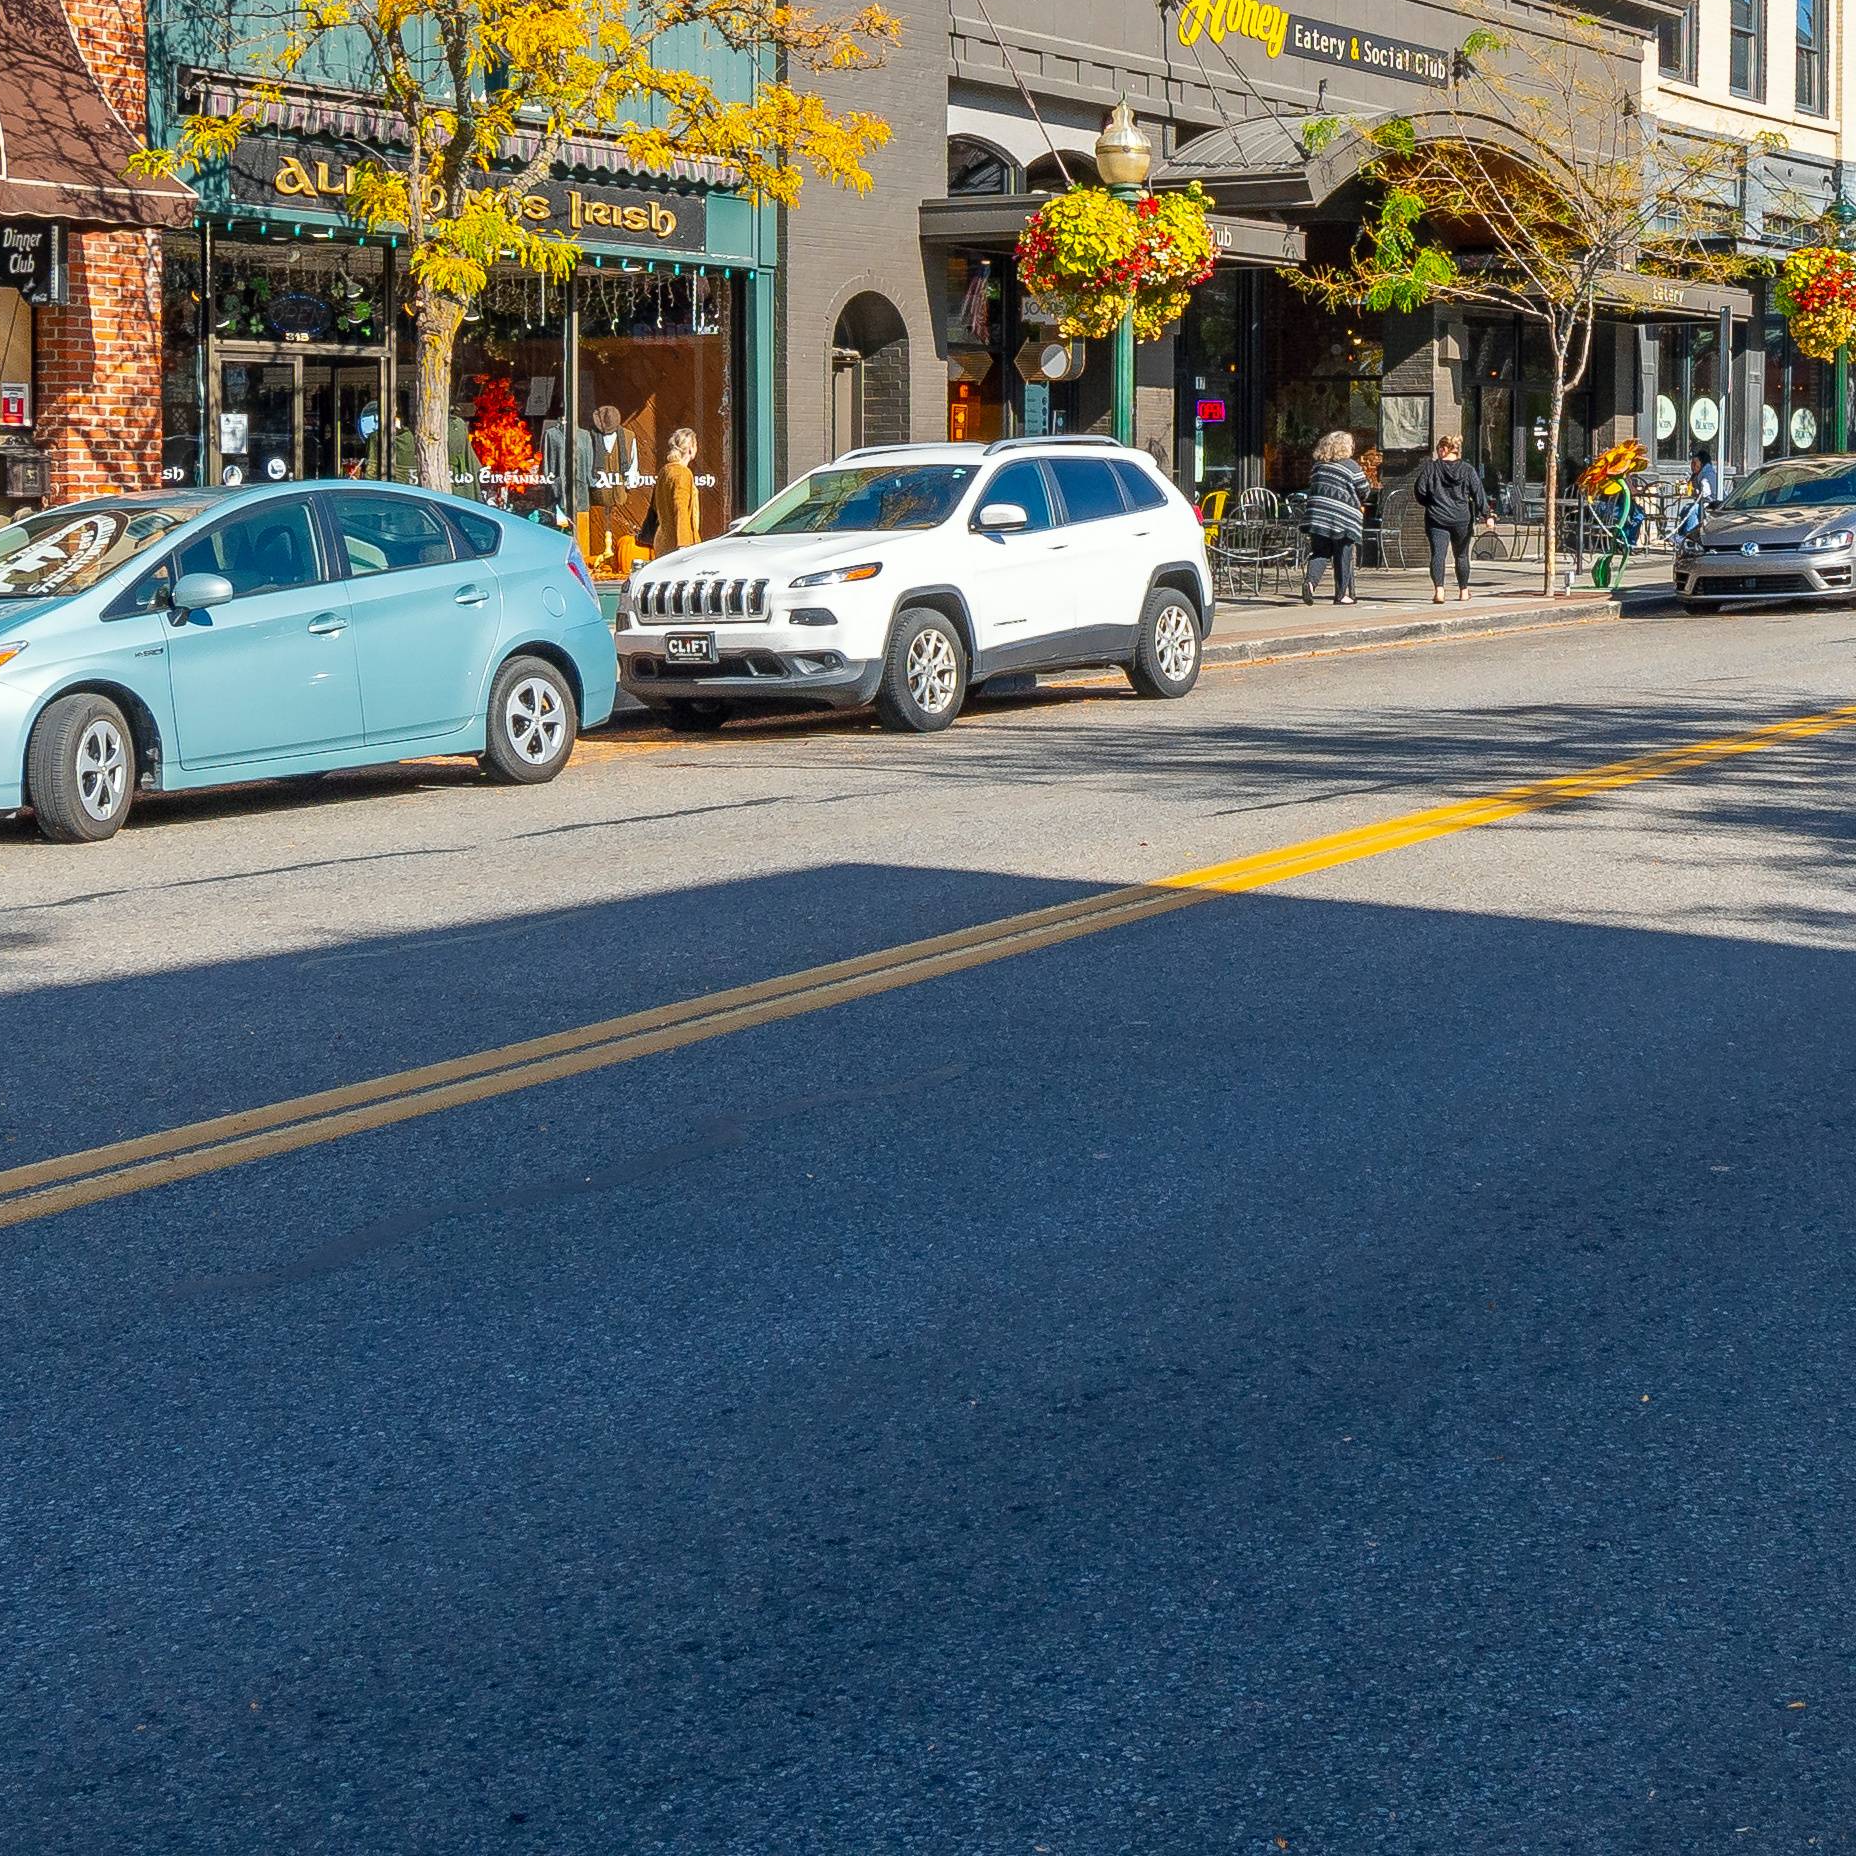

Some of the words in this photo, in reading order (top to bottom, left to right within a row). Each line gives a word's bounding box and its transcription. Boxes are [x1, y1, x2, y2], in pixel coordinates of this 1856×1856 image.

[1295, 24, 1345, 61] Eatery
[1351, 37, 1359, 60] &
[1364, 41, 1410, 72] Social
[1415, 53, 1445, 80] Club
[568, 190, 677, 239] Irish
[3, 228, 42, 252] Dinner
[10, 253, 35, 273] Club
